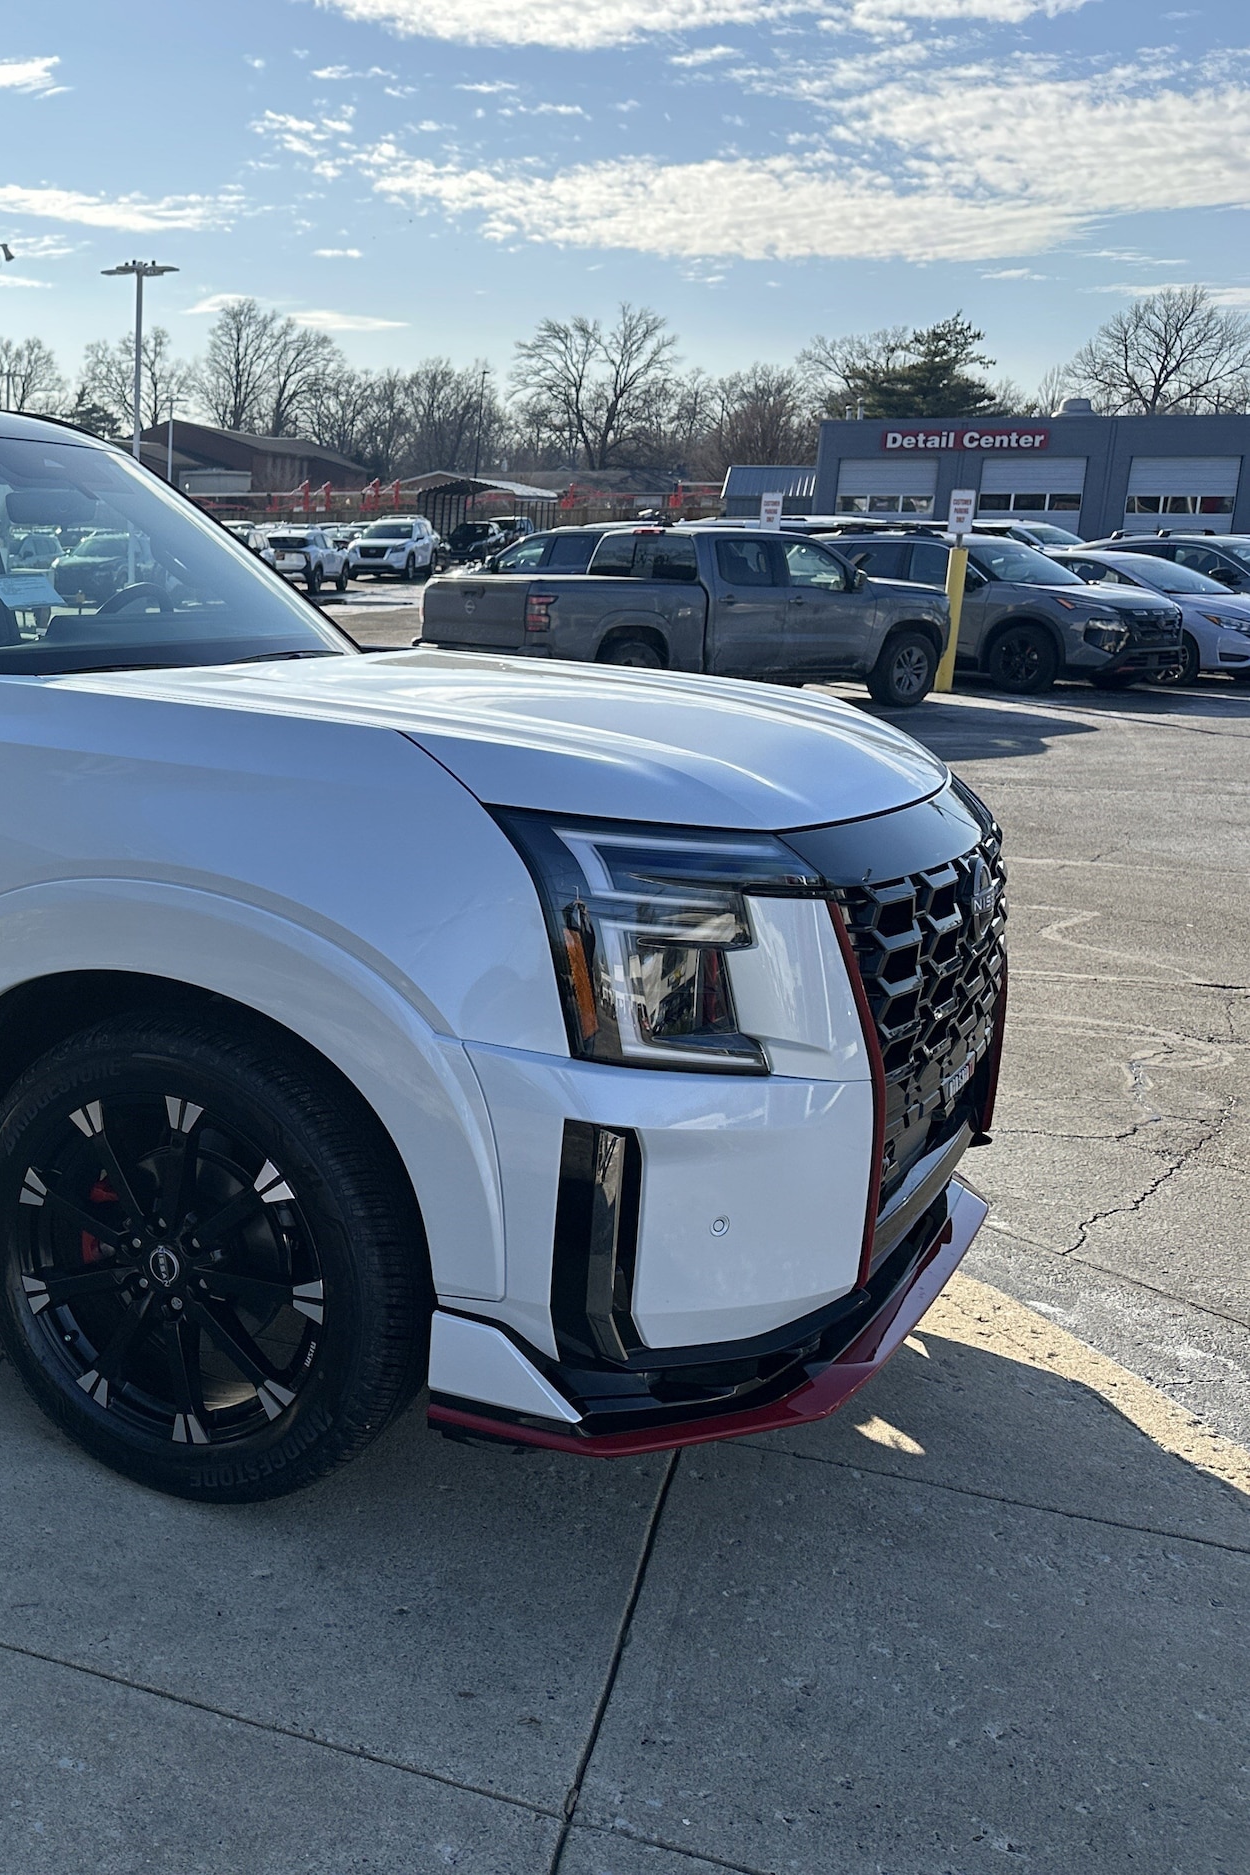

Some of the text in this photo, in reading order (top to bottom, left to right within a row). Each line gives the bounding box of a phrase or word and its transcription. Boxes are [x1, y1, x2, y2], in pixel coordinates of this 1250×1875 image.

[886, 431, 1044, 448] Detail Center
[157, 1245, 171, 1287] NISSAN
